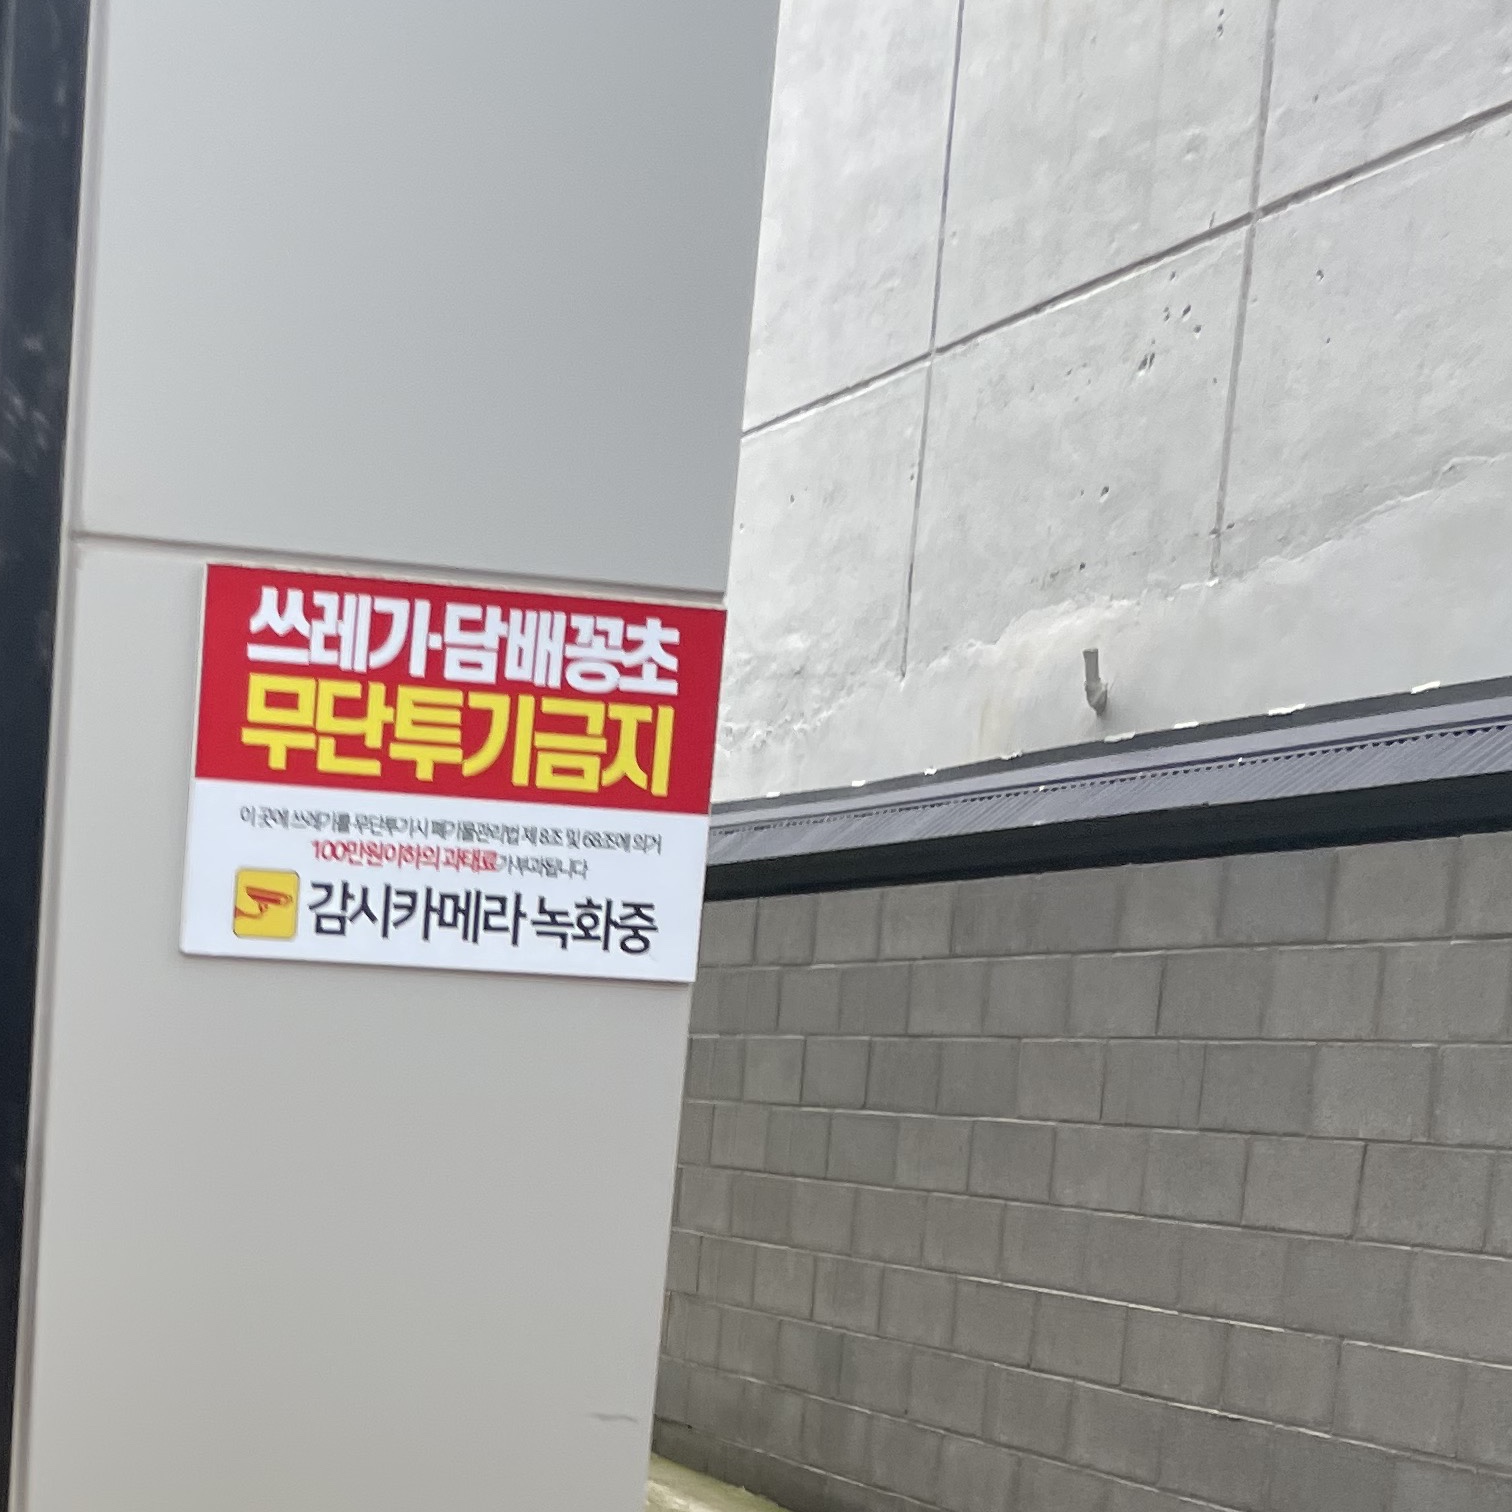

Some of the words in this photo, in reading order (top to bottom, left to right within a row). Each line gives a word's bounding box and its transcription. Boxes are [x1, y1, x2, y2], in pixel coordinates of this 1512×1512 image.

[241, 672, 675, 797] 무단투기금지
[307, 879, 526, 946] 감시카메라
[529, 894, 659, 955] 녹화중
